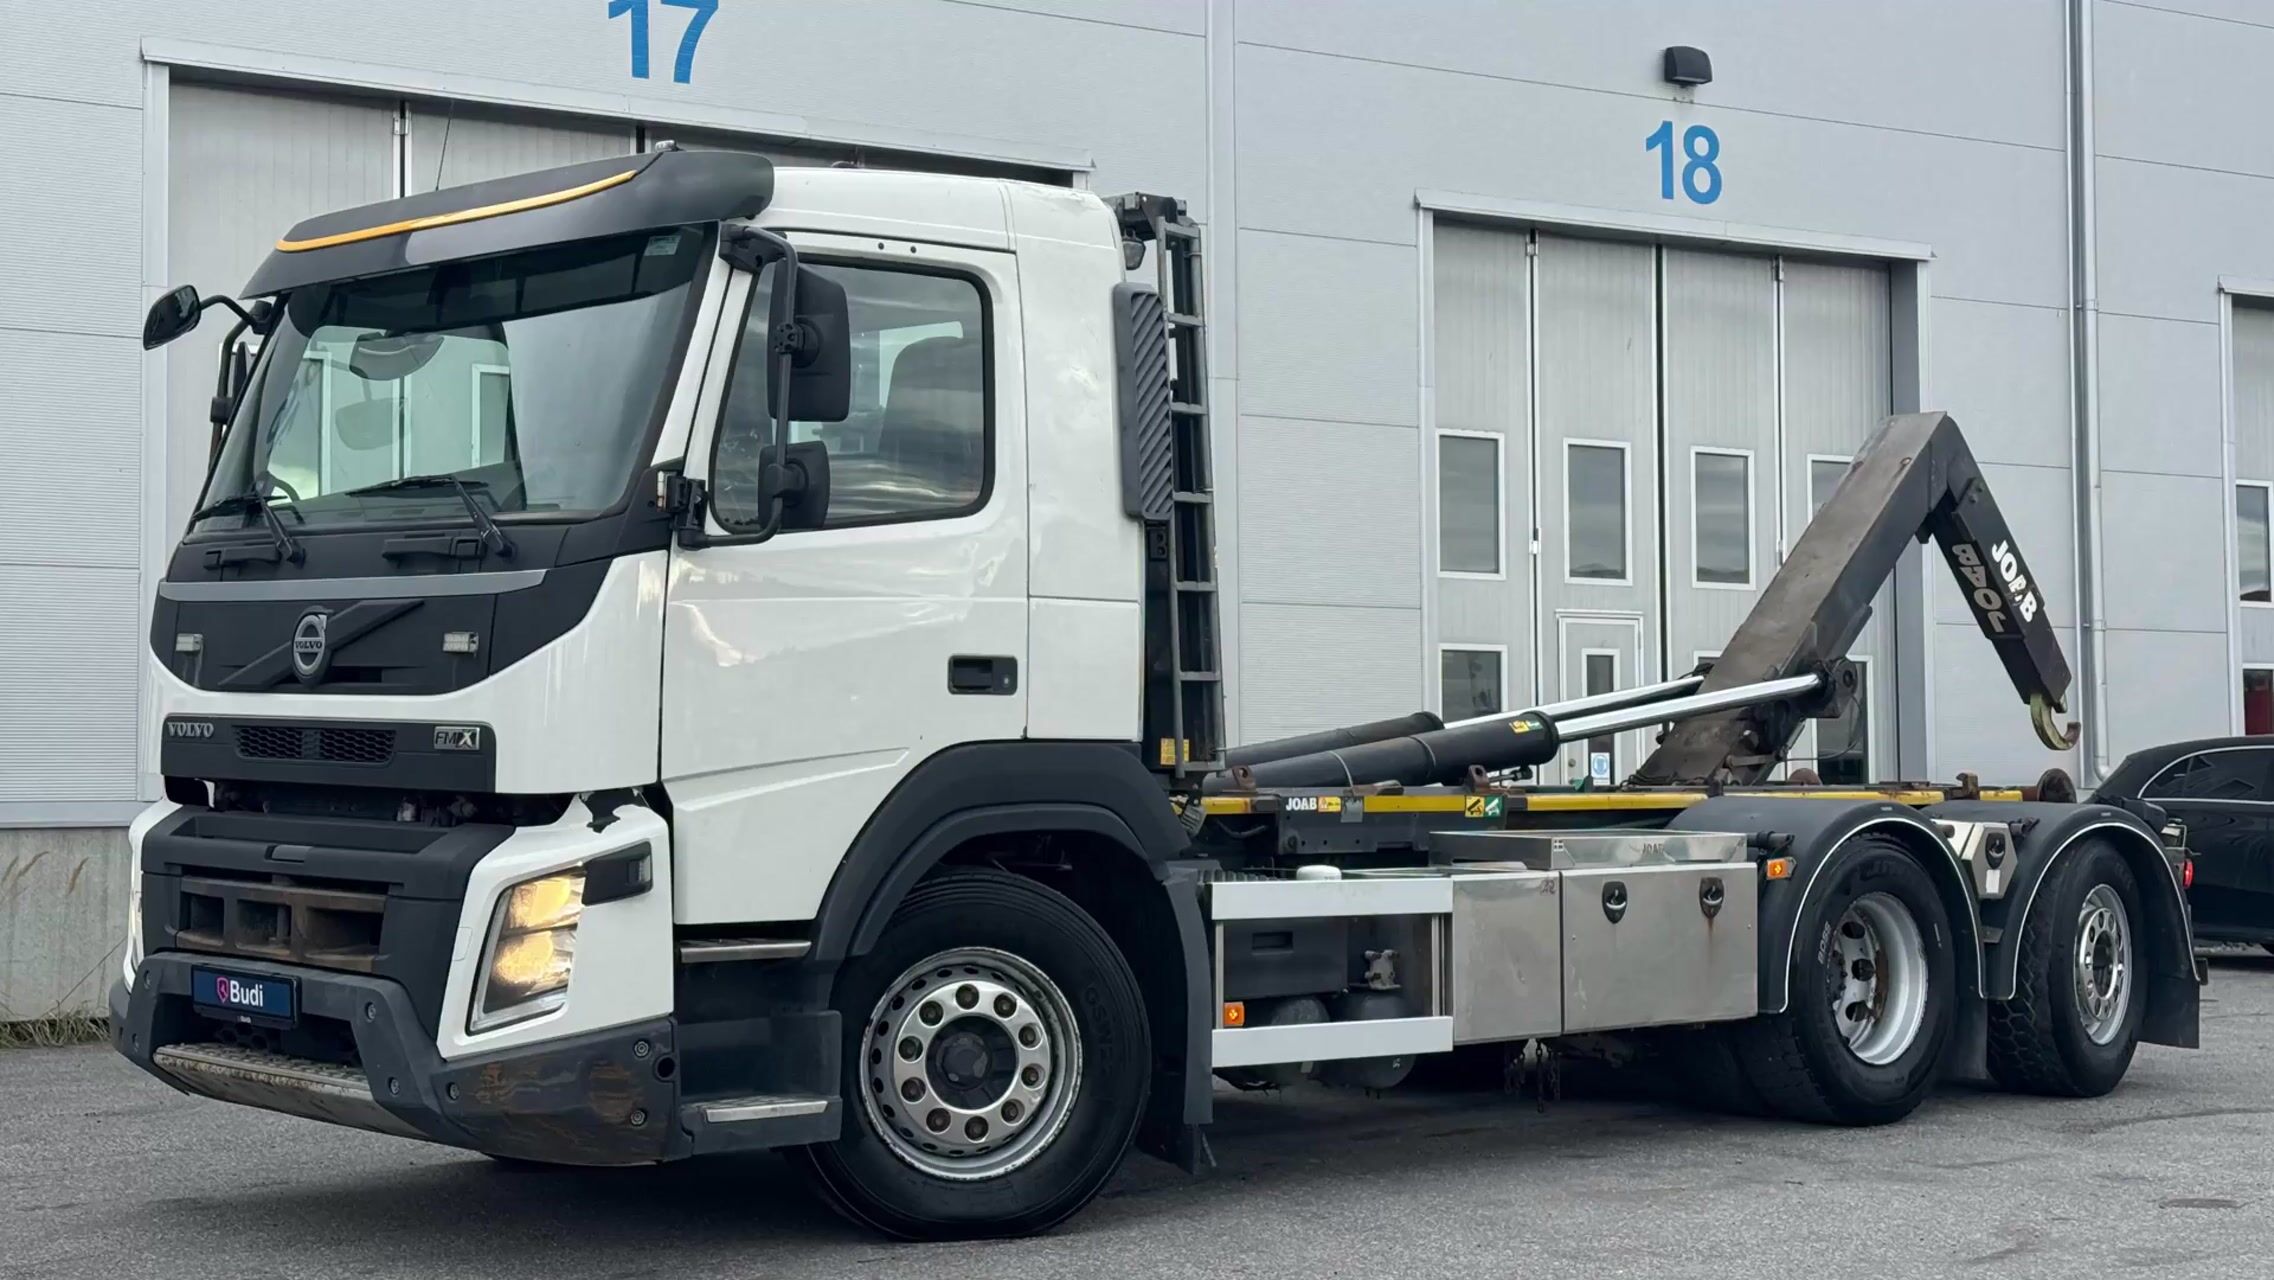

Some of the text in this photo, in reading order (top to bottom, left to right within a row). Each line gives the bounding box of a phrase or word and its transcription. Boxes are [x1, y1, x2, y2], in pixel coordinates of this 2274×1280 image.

[608, 0, 719, 84] 17
[1645, 120, 1722, 205] 18
[1952, 543, 2007, 633] JOAB
[1991, 540, 2037, 622] JOAB
[295, 640, 323, 649] VOLVO
[167, 721, 214, 738] VOLVO
[435, 730, 474, 747] FMX
[1285, 797, 1318, 811] JOAB
[230, 980, 264, 1007] Budi
